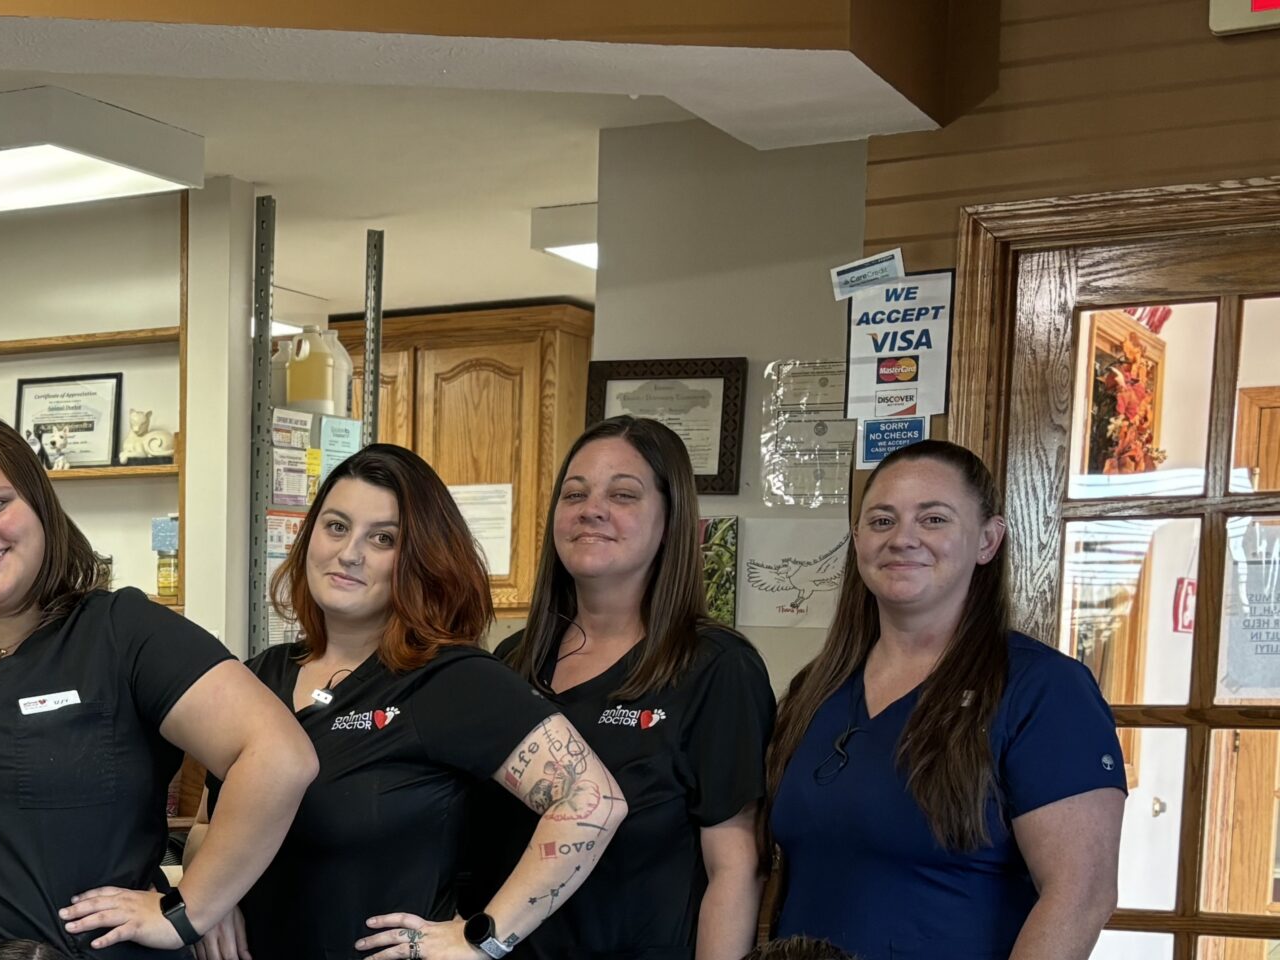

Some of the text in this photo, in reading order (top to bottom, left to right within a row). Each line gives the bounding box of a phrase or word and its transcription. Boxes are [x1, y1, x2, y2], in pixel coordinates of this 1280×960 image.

[884, 286, 919, 302] WE
[856, 305, 946, 326] ACCEPT
[867, 328, 933, 353] VISA
[879, 365, 917, 375] MasterCard
[877, 395, 915, 404] DISCOVER
[880, 422, 909, 431] SORRY
[869, 430, 919, 440] NO CHECKS
[335, 710, 373, 723] animal
[602, 705, 641, 719] animal
[331, 720, 372, 730] DOCTOR
[598, 716, 638, 727] DOCTOR
